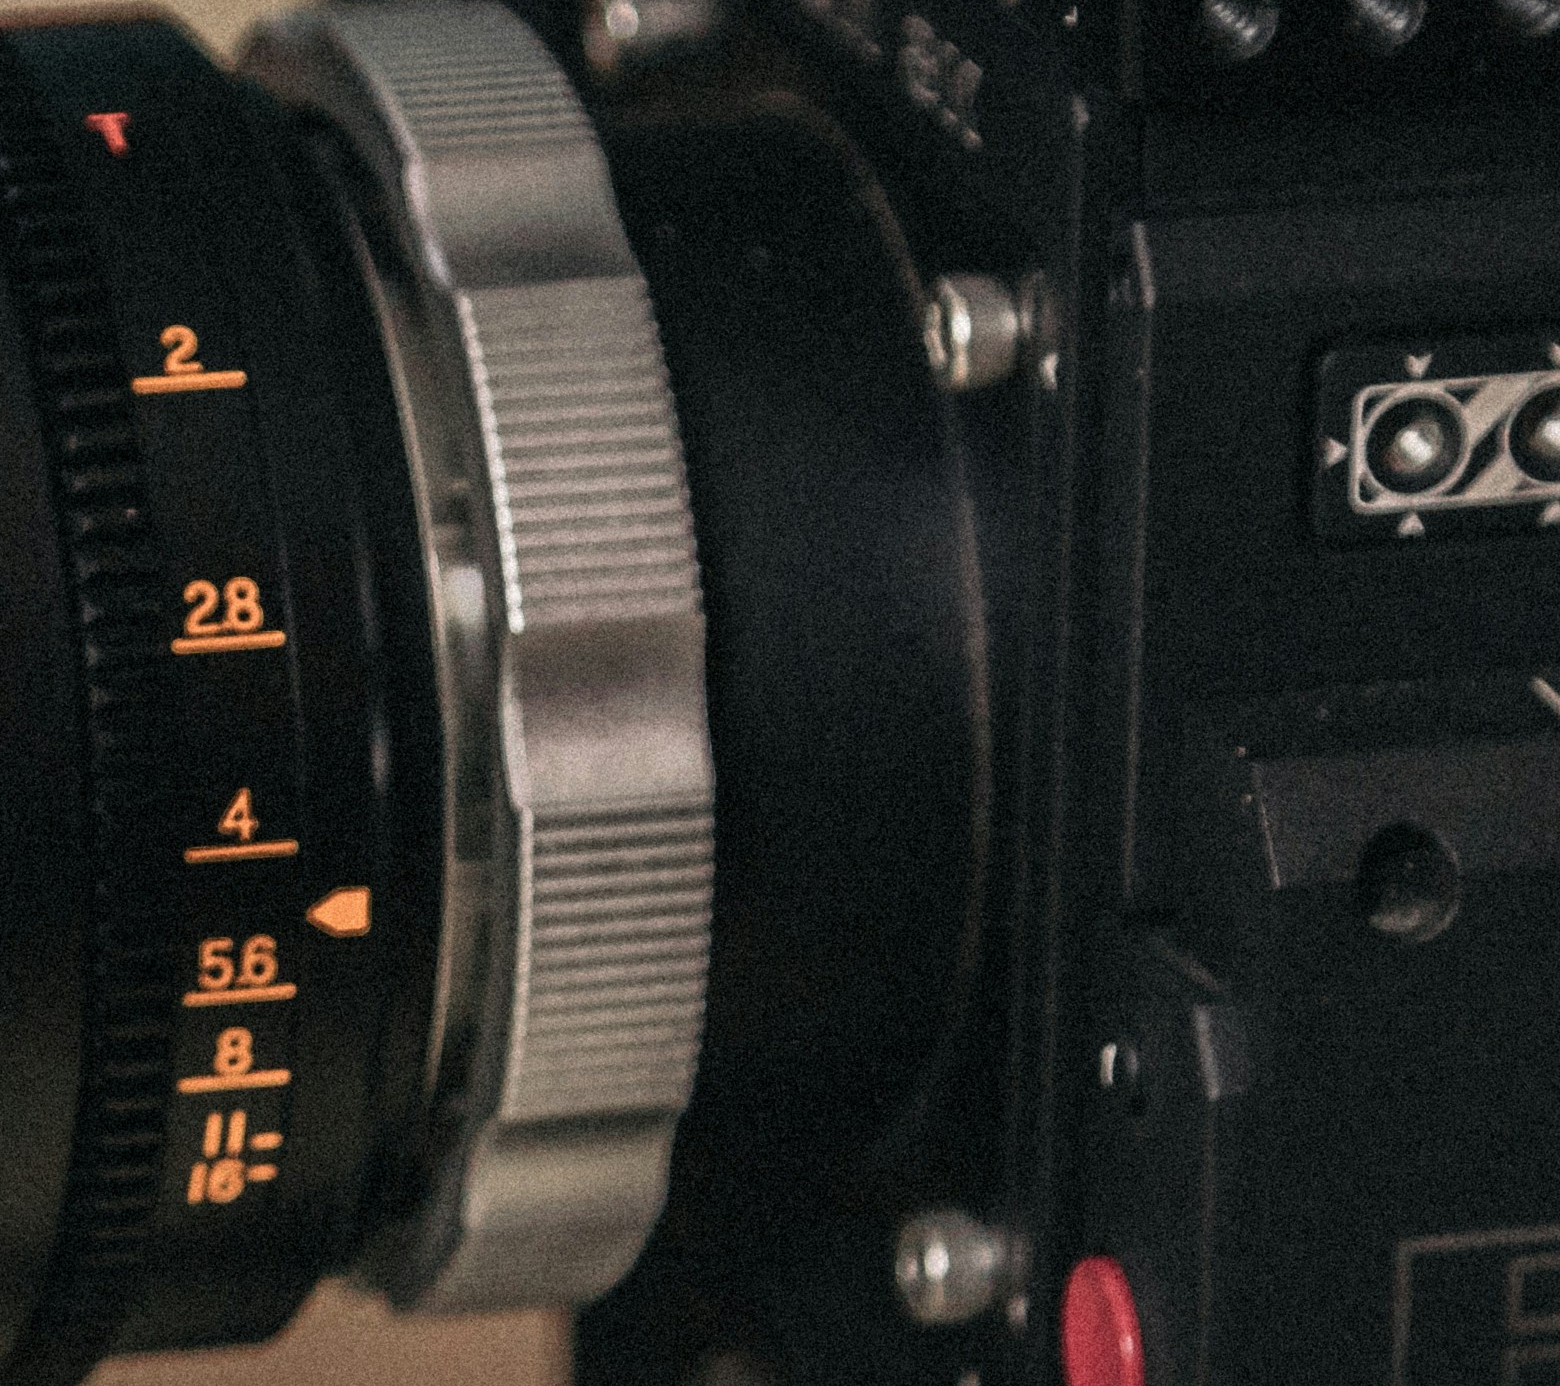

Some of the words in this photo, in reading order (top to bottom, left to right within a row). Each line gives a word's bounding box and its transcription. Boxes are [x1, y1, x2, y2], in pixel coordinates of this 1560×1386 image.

[159, 324, 204, 375] 2
[218, 786, 259, 841] 4
[213, 1025, 254, 1075] 8
